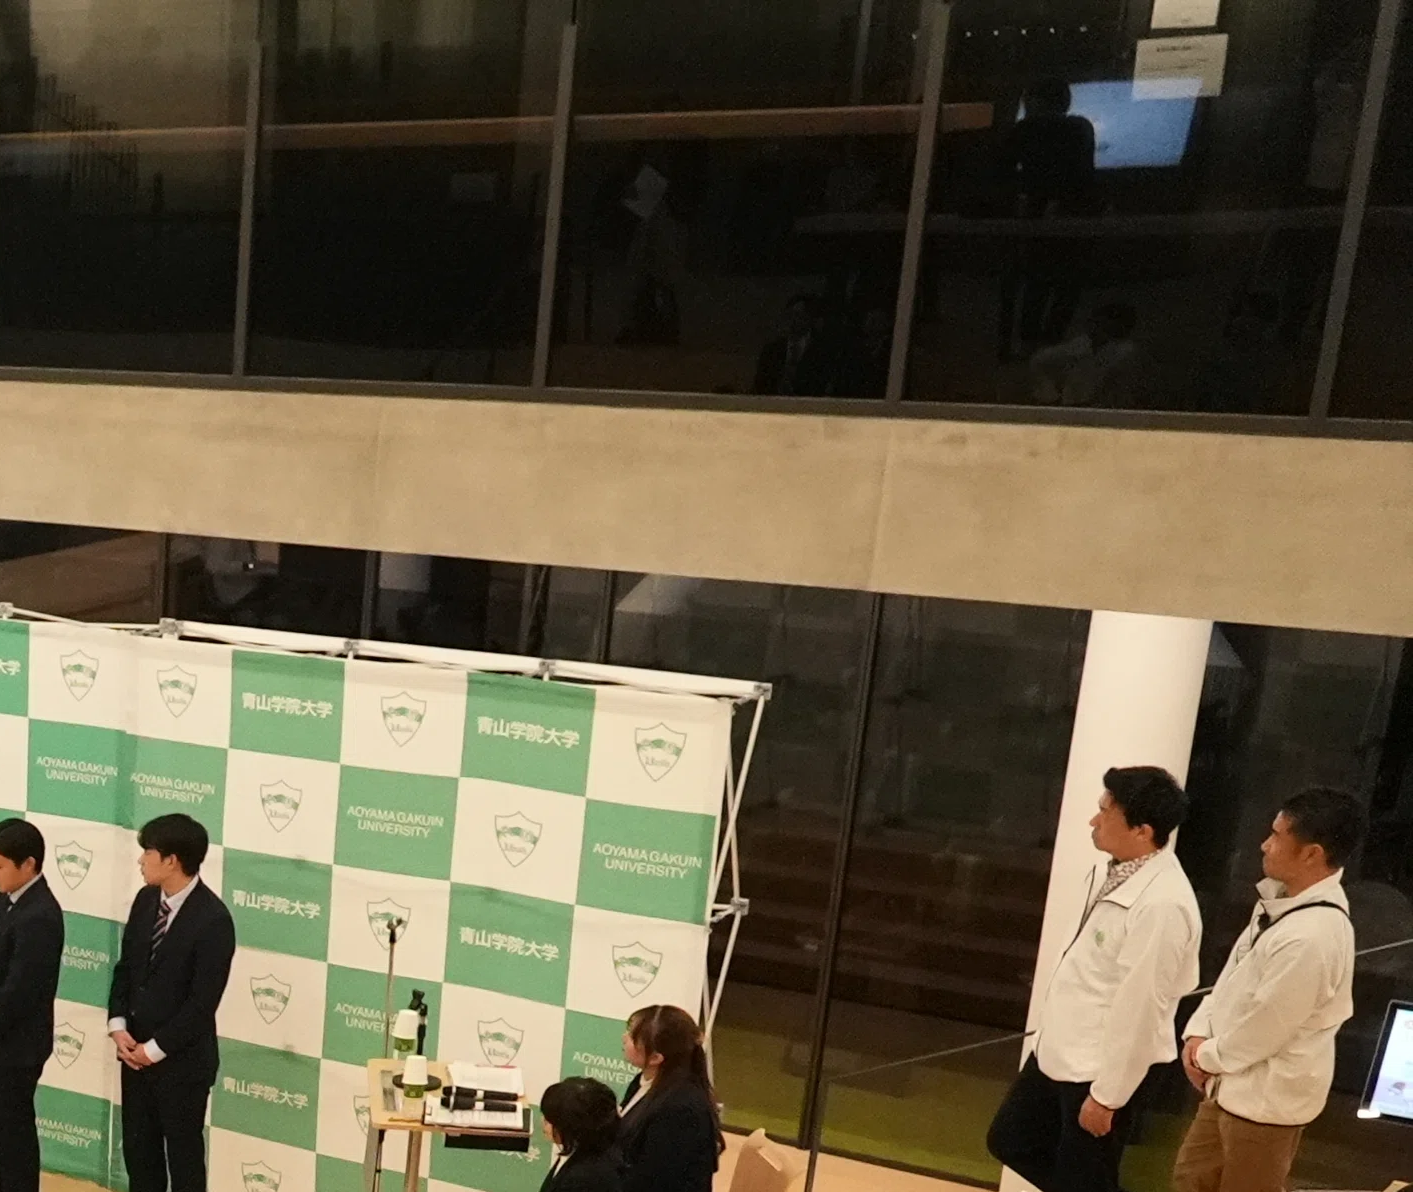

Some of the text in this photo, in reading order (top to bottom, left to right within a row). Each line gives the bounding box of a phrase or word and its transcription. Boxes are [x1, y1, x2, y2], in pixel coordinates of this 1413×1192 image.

[242, 692, 333, 718] 青山学院大学
[477, 716, 580, 748] 青山学院大学
[36, 756, 118, 777] AOYAMA GAKUIN
[46, 769, 108, 786] UNIVERSITY
[130, 772, 215, 795] AOYAMA GAKUIN
[139, 786, 204, 804] UNIVERSITY
[347, 806, 444, 827] AOYAMA GAKUIN
[357, 820, 430, 838] UNIVERSITY
[593, 843, 703, 868] AOYAMA GAKUIN
[605, 858, 688, 879] UNIVERSITY
[233, 889, 320, 919] 青山学院大学
[460, 926, 559, 962] 青山学院大学
[72, 947, 110, 964] GAKUIN
[335, 1003, 382, 1021] AOYAMA
[573, 1052, 626, 1071] AOYAMA
[223, 1076, 308, 1110] 青山学院大学
[64, 1124, 101, 1141] GAKUIN
